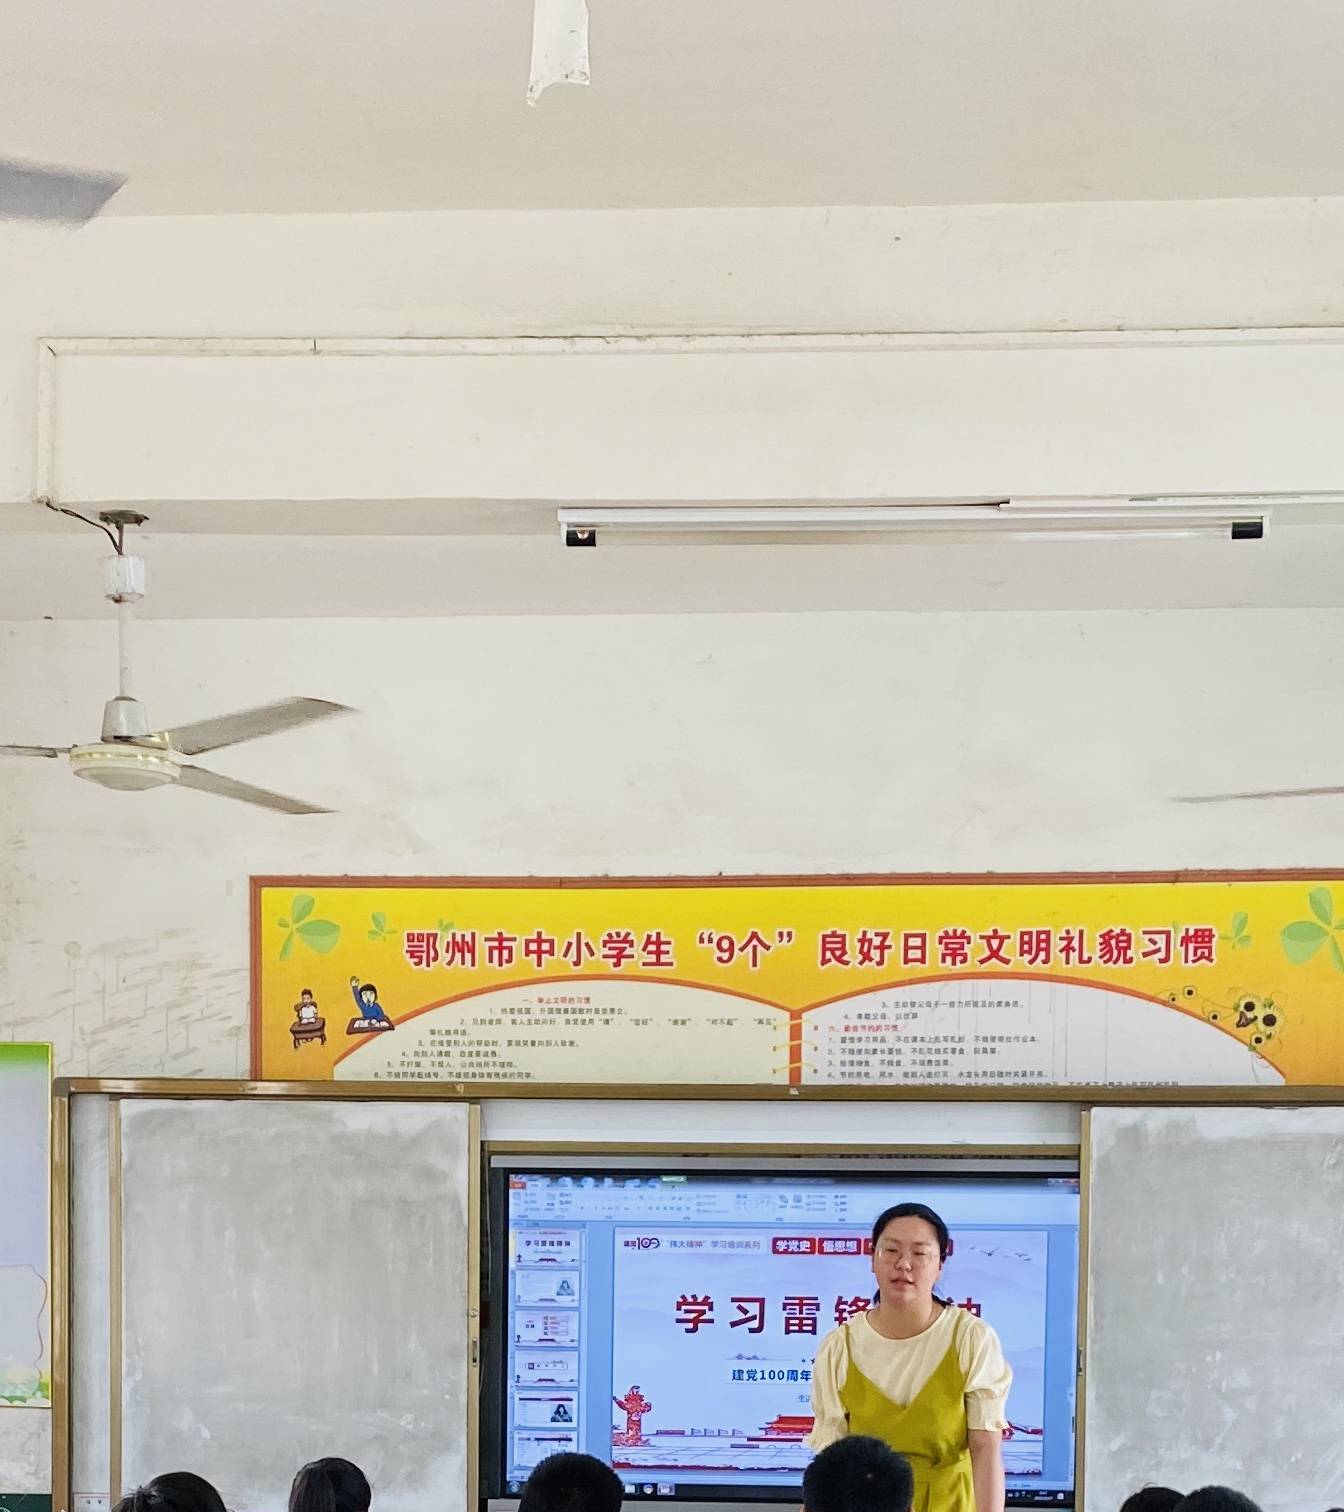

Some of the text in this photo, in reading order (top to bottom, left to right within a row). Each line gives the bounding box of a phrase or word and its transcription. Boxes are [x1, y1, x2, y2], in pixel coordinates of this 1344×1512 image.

[405, 928, 1216, 968] 鄂州市中小学生“9个”良好日常文明礼貌习惯
